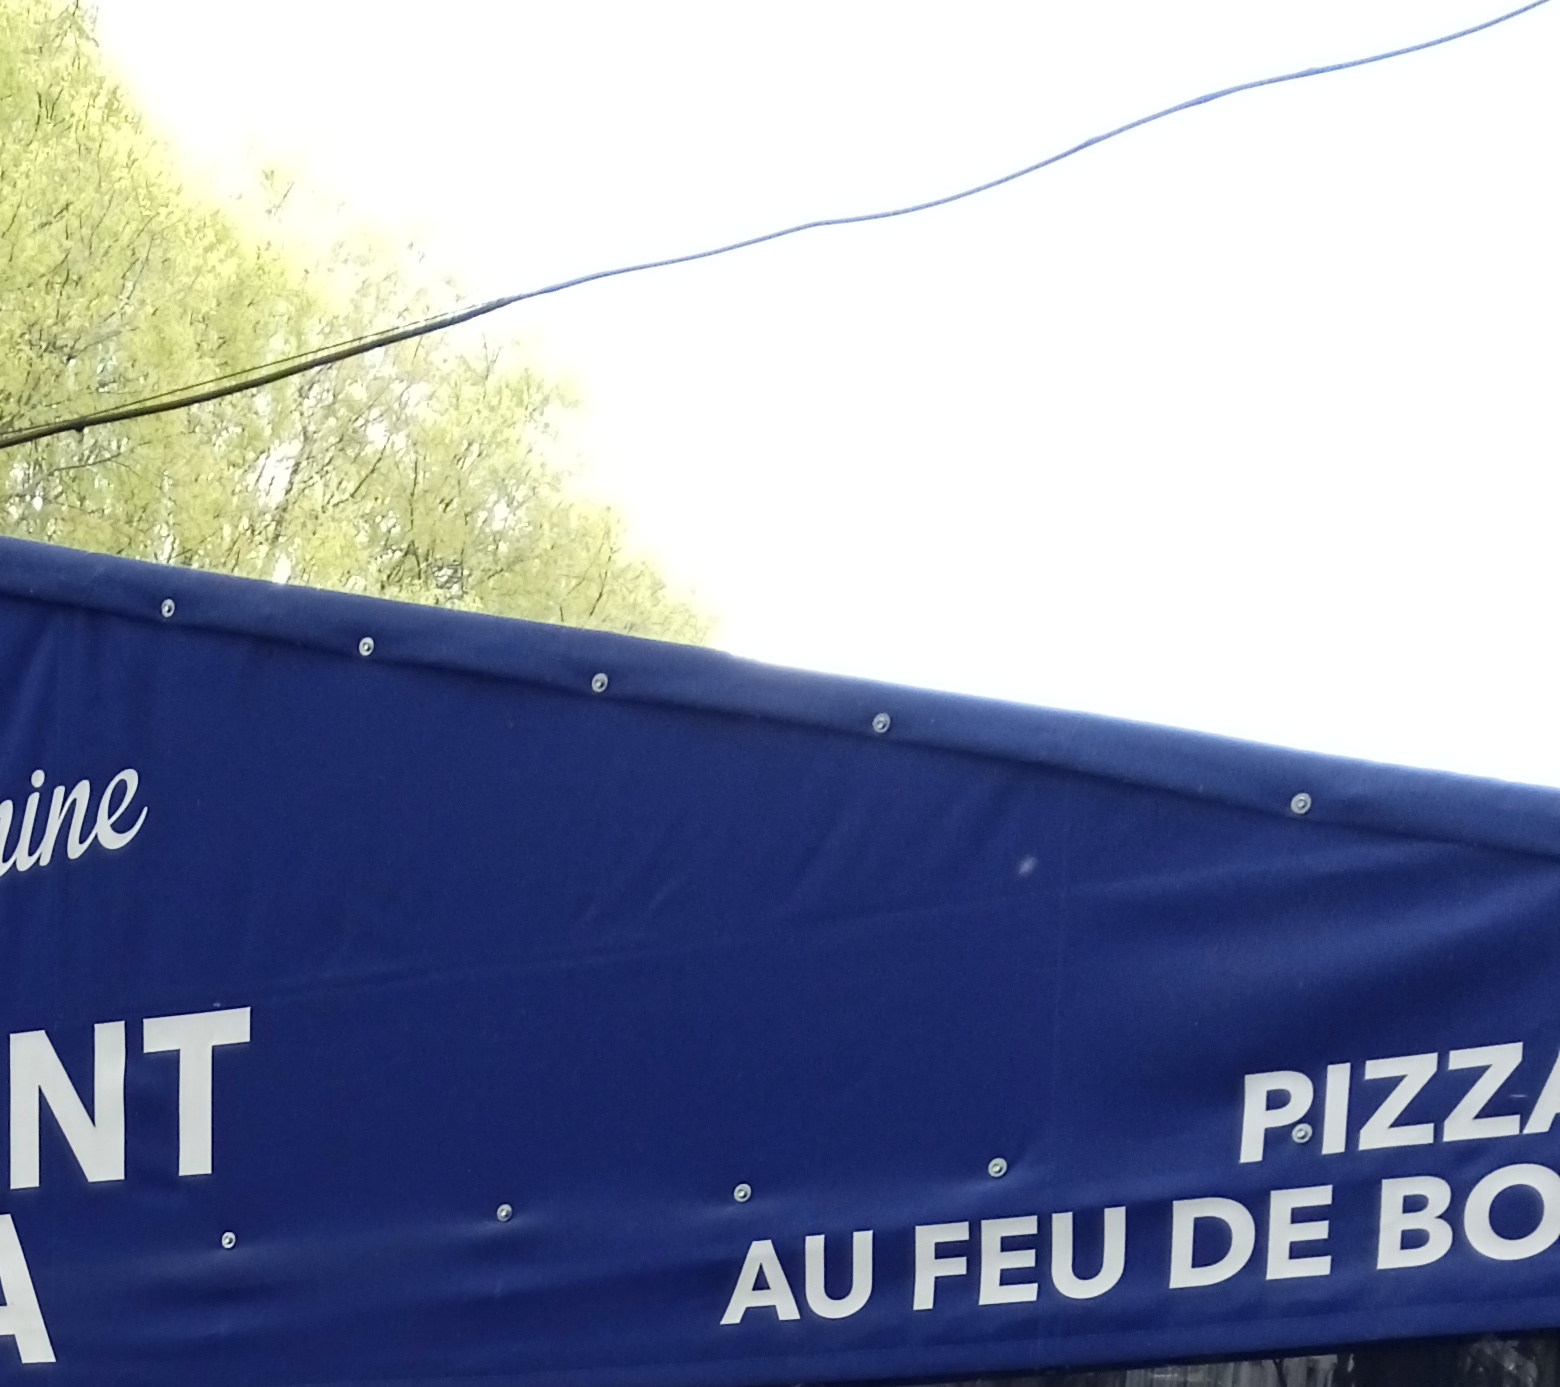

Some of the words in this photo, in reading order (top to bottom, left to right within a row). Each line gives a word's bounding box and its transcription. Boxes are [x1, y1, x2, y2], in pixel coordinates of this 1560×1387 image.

[720, 1230, 874, 1325] AU
[912, 1206, 1127, 1310] FEU
[1169, 1185, 1334, 1289] DE
